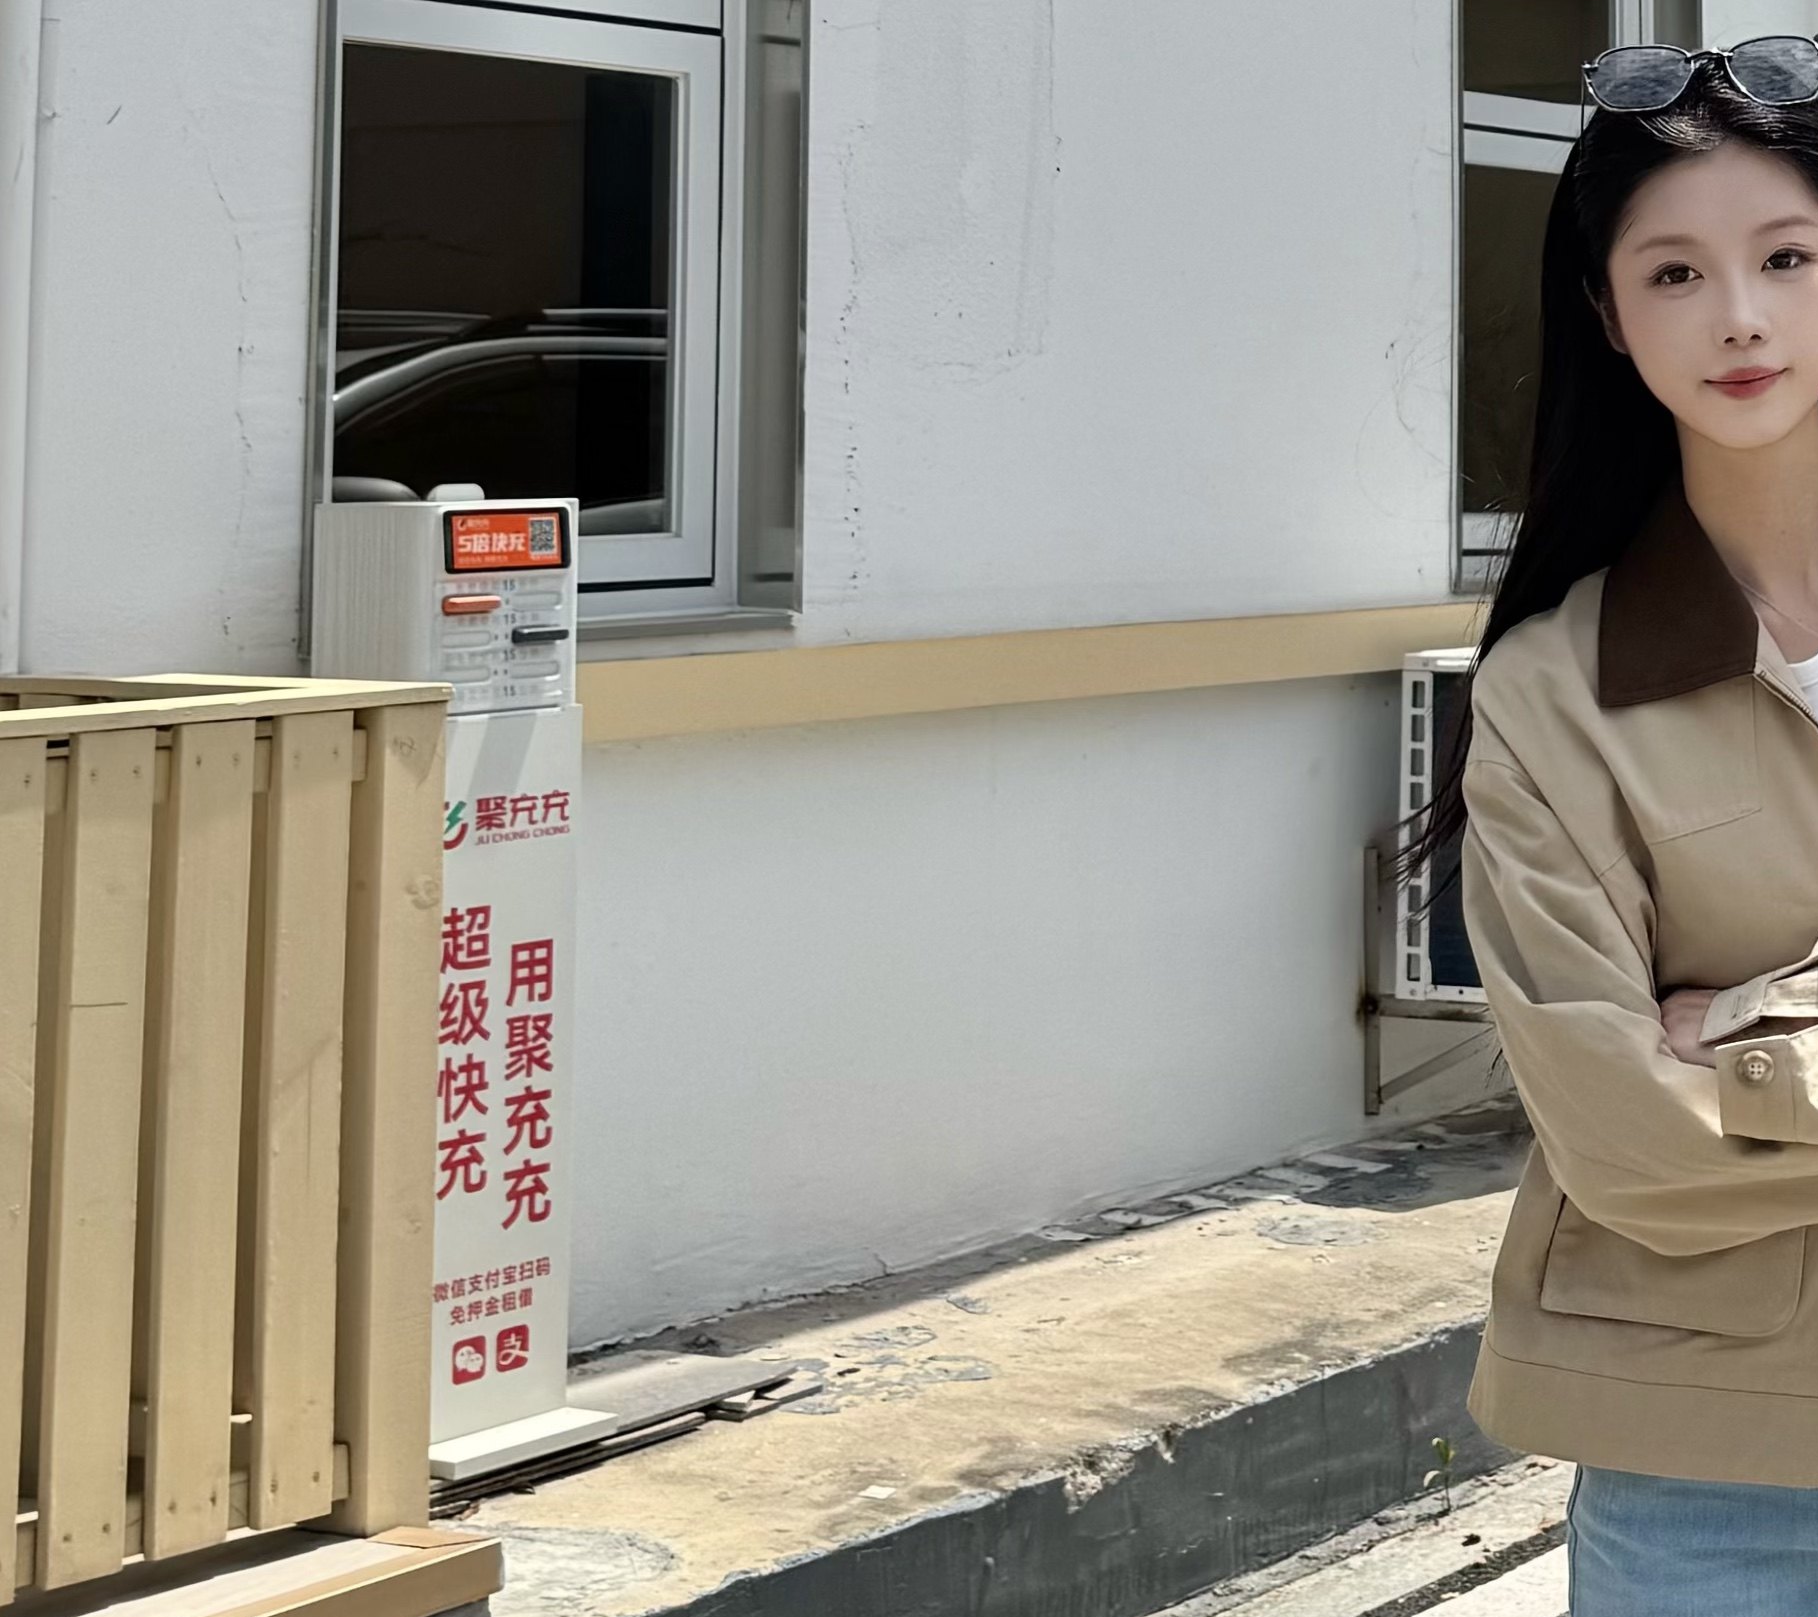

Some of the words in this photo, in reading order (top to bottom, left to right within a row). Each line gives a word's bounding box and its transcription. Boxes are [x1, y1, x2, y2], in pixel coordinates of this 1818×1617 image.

[458, 533, 526, 553] 5倍快充
[475, 790, 570, 831] 聚充充
[492, 830, 530, 843] CHONG
[533, 825, 570, 838] CHONG
[437, 905, 491, 1200] 超级快充
[502, 938, 553, 1230] 用聚充充
[433, 1256, 551, 1303] 微信支付宝扫码
